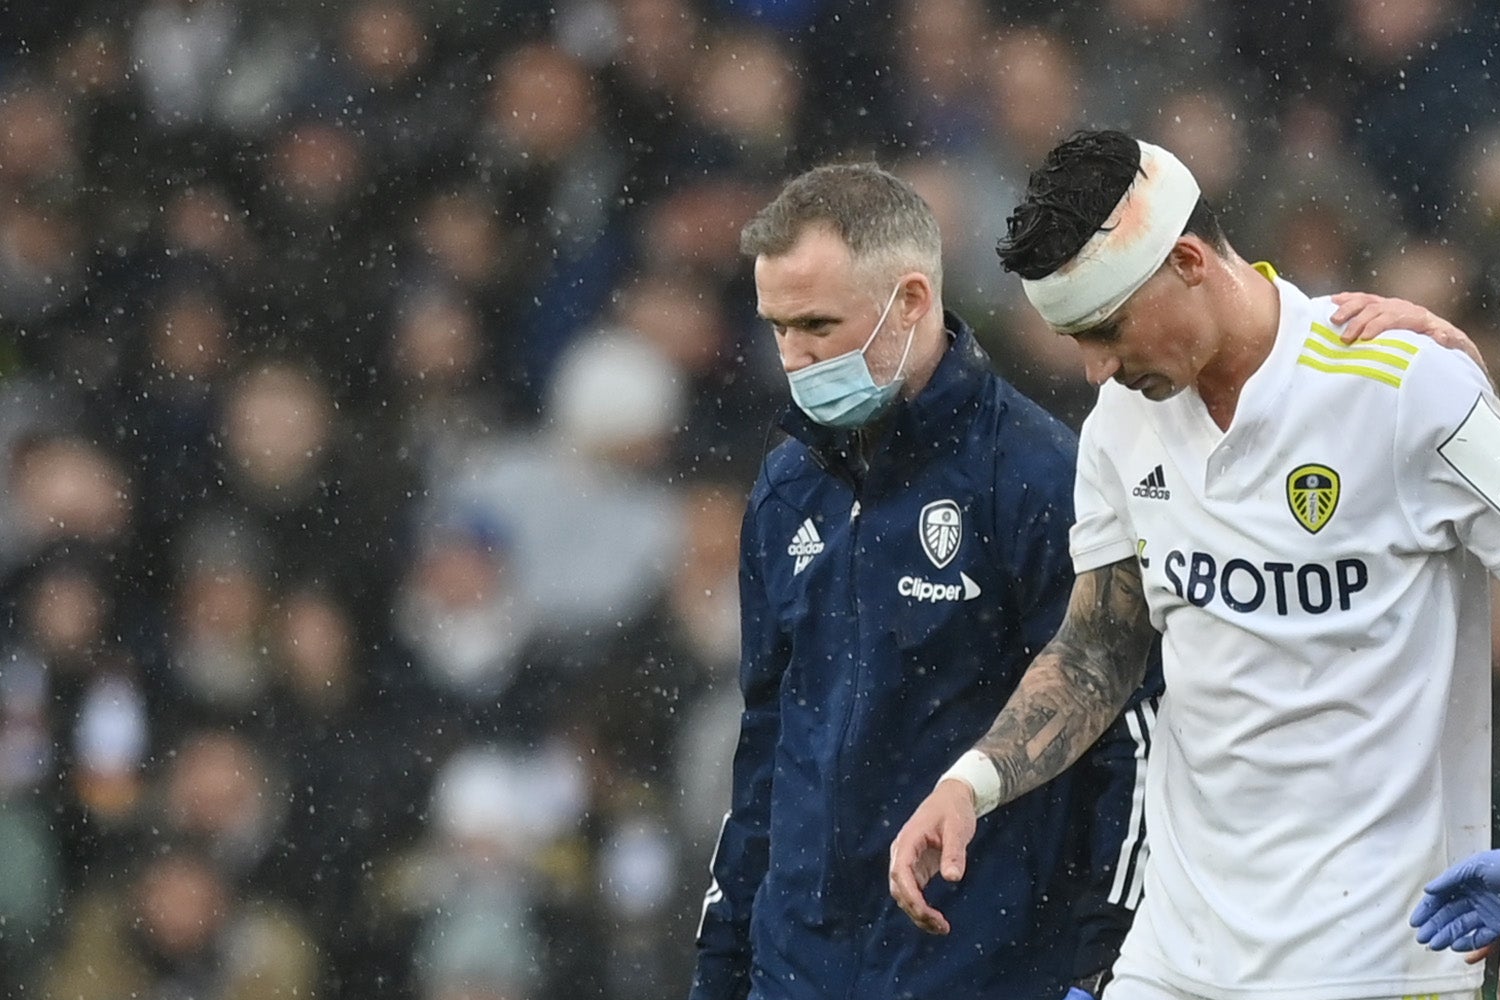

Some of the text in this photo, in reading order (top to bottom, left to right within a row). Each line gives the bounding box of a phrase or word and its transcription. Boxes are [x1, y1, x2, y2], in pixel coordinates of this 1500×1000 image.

[1132, 484, 1171, 501] adidas
[897, 575, 962, 603] Clipper
[1164, 550, 1369, 616] SBOTOP
